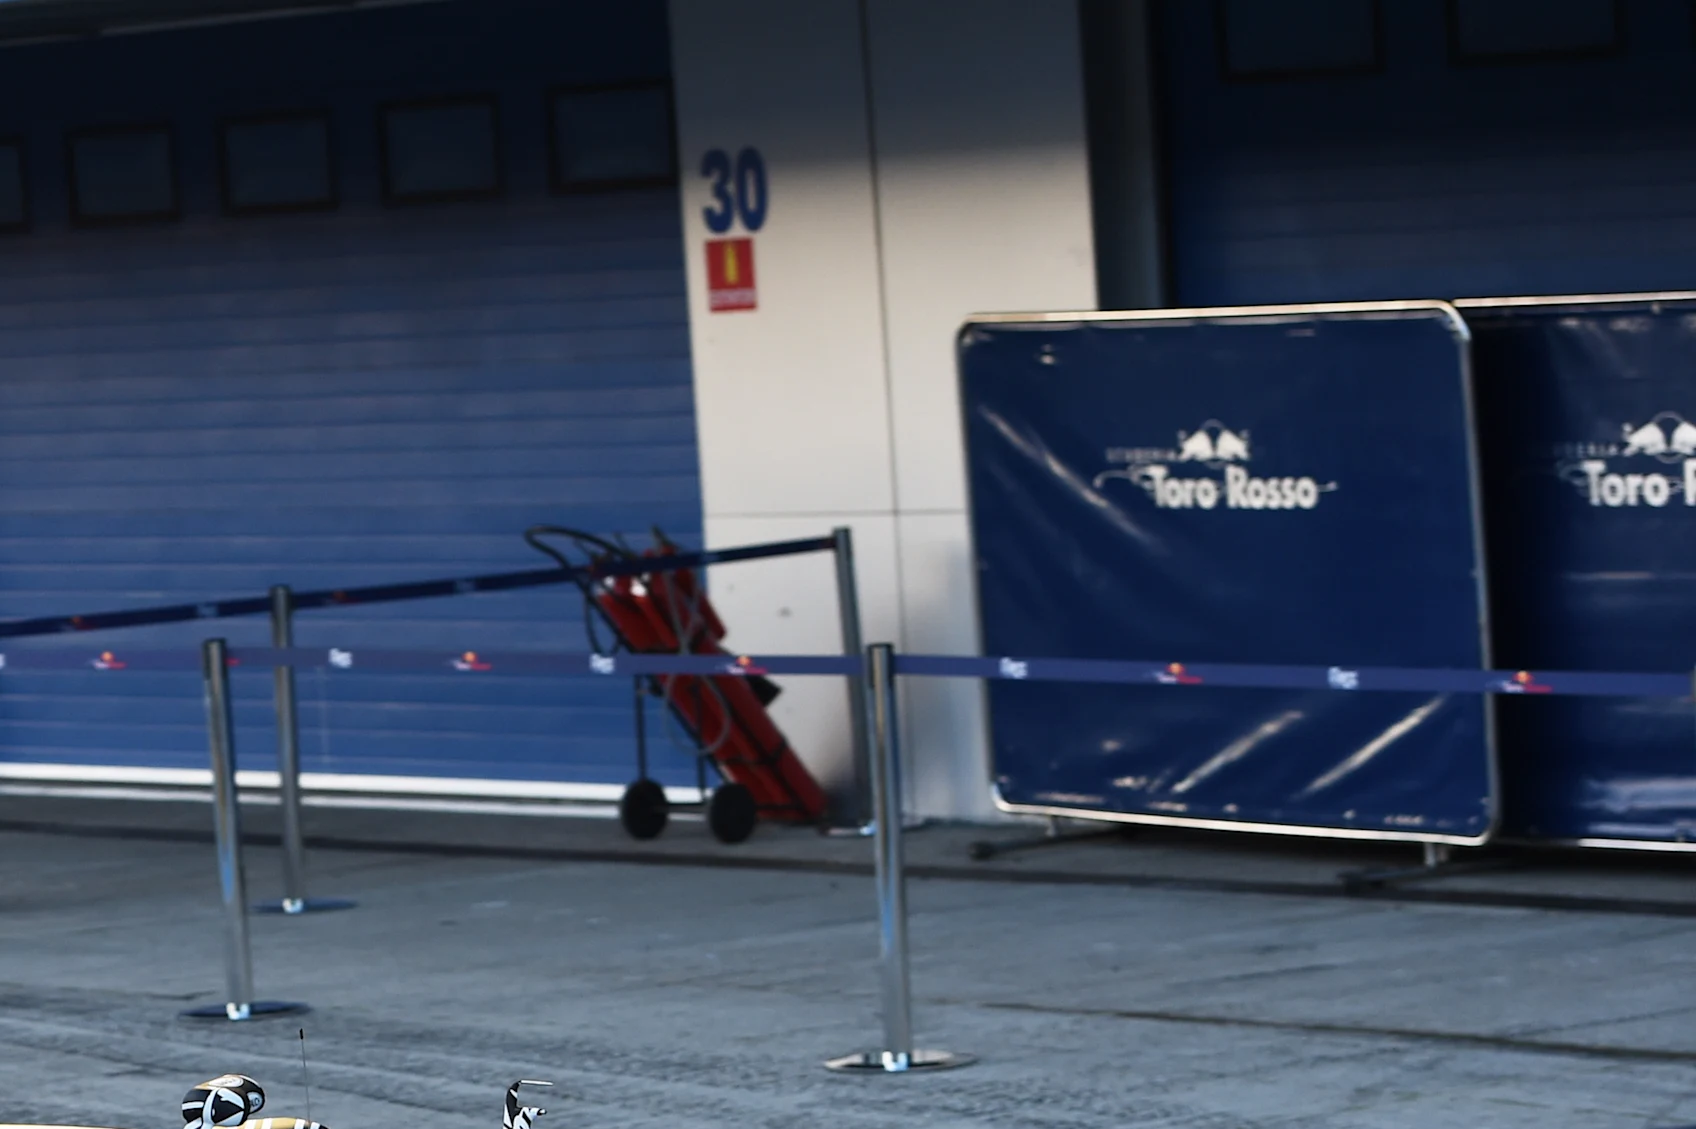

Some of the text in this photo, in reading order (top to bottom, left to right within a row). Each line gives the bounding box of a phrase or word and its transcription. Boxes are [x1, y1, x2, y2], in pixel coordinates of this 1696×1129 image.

[700, 145, 769, 234] 30
[1144, 463, 1320, 509] Toro Rosso
[1581, 459, 1670, 507] Toro
